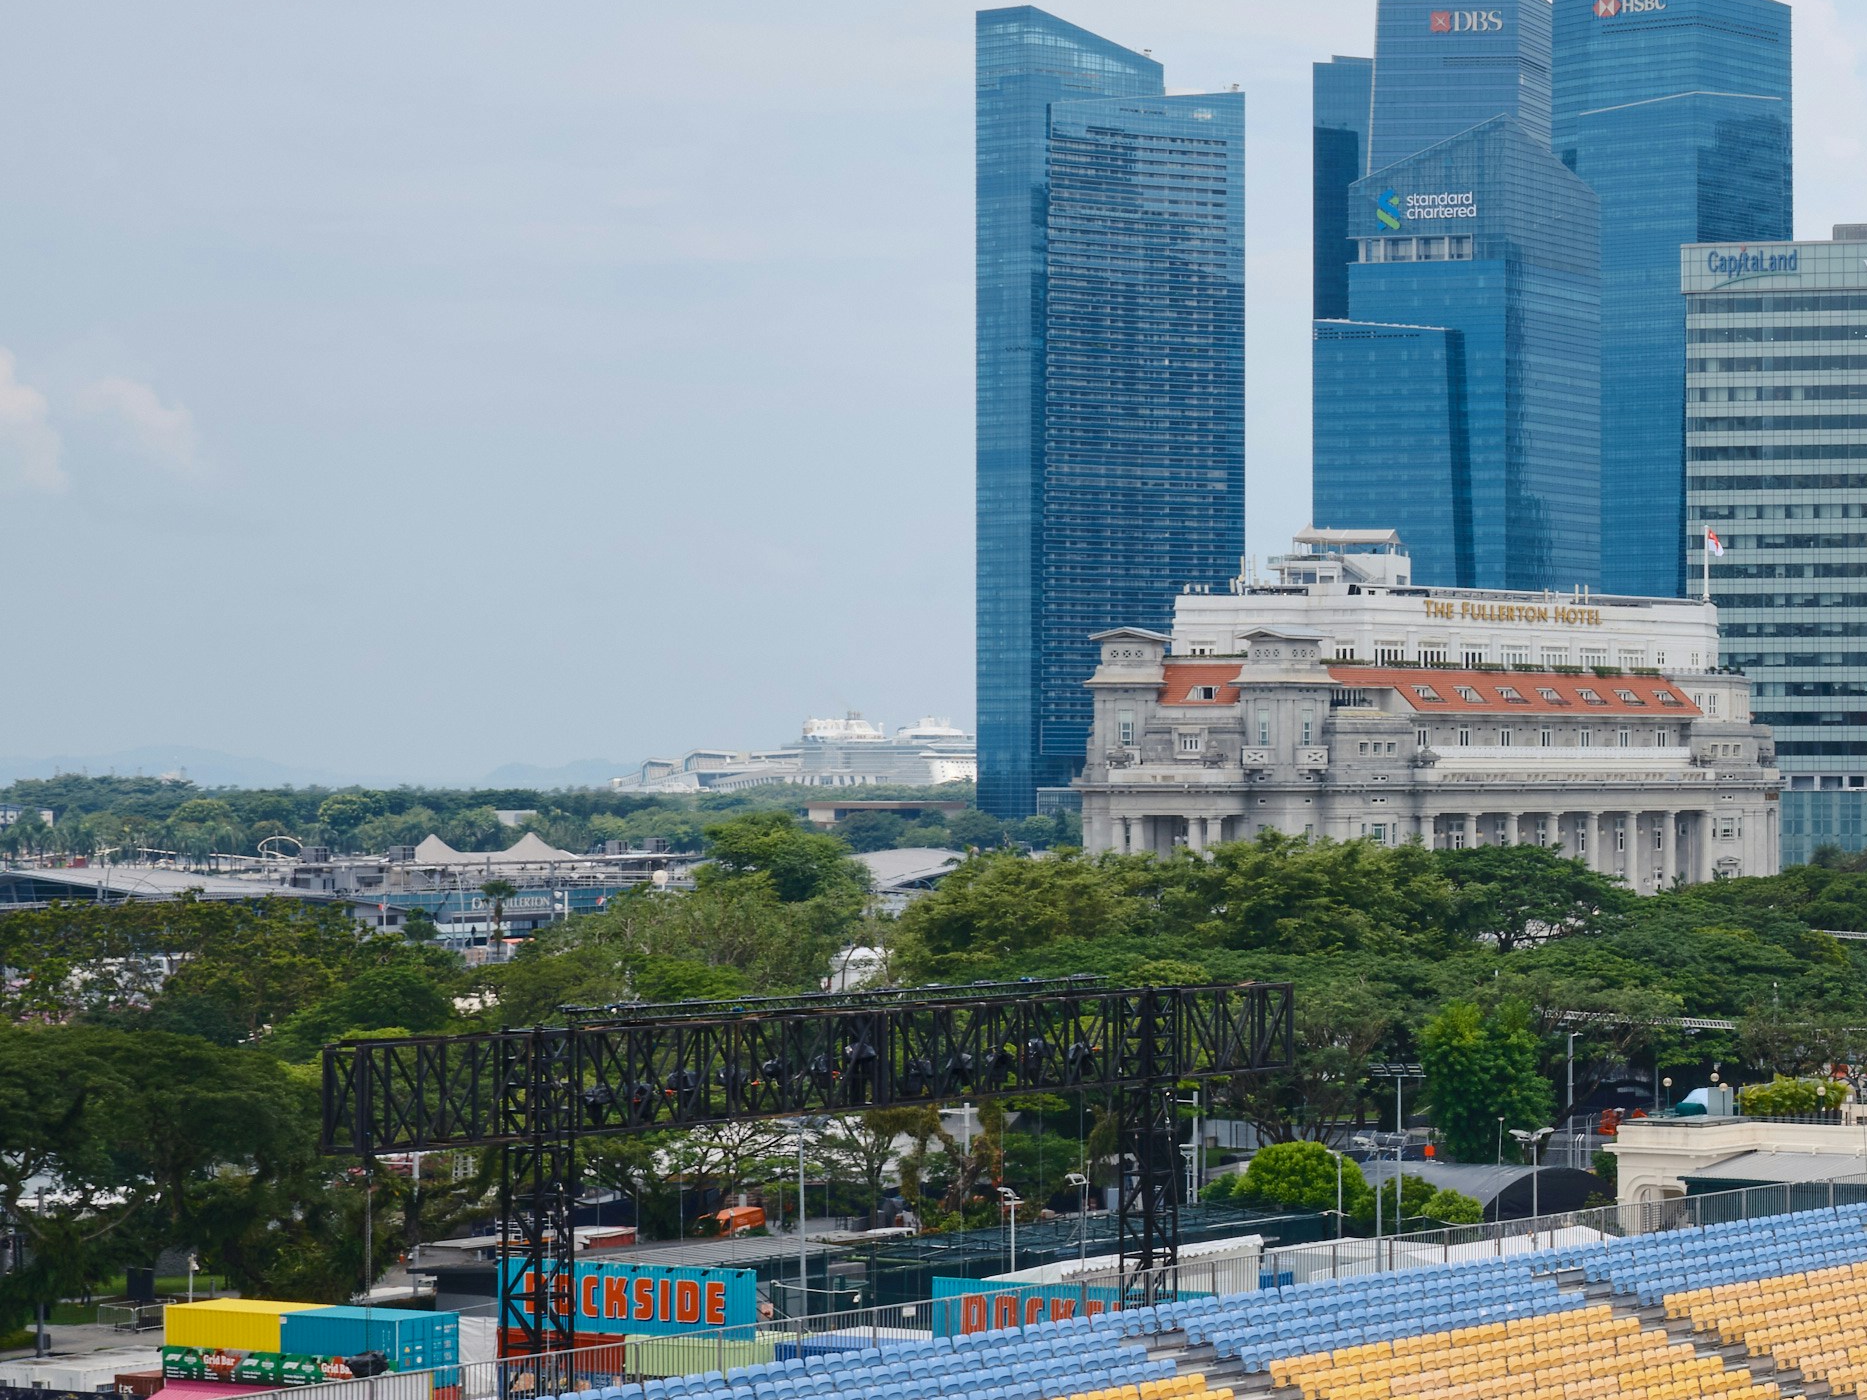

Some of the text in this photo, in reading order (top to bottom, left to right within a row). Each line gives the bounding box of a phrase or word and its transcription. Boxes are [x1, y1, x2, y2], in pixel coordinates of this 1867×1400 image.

[1454, 10, 1503, 32] DBS
[1407, 191, 1473, 208] standard
[1407, 203, 1476, 221] chartered
[1707, 245, 1797, 277] CapitaLand
[1423, 599, 1602, 625] THE FULLERTON HOTEL
[502, 896, 550, 908] ULLERTON
[203, 1354, 220, 1365] Grid
[221, 1355, 236, 1366] Bar
[320, 1362, 339, 1373] Grid
[339, 1364, 352, 1374] Ba
